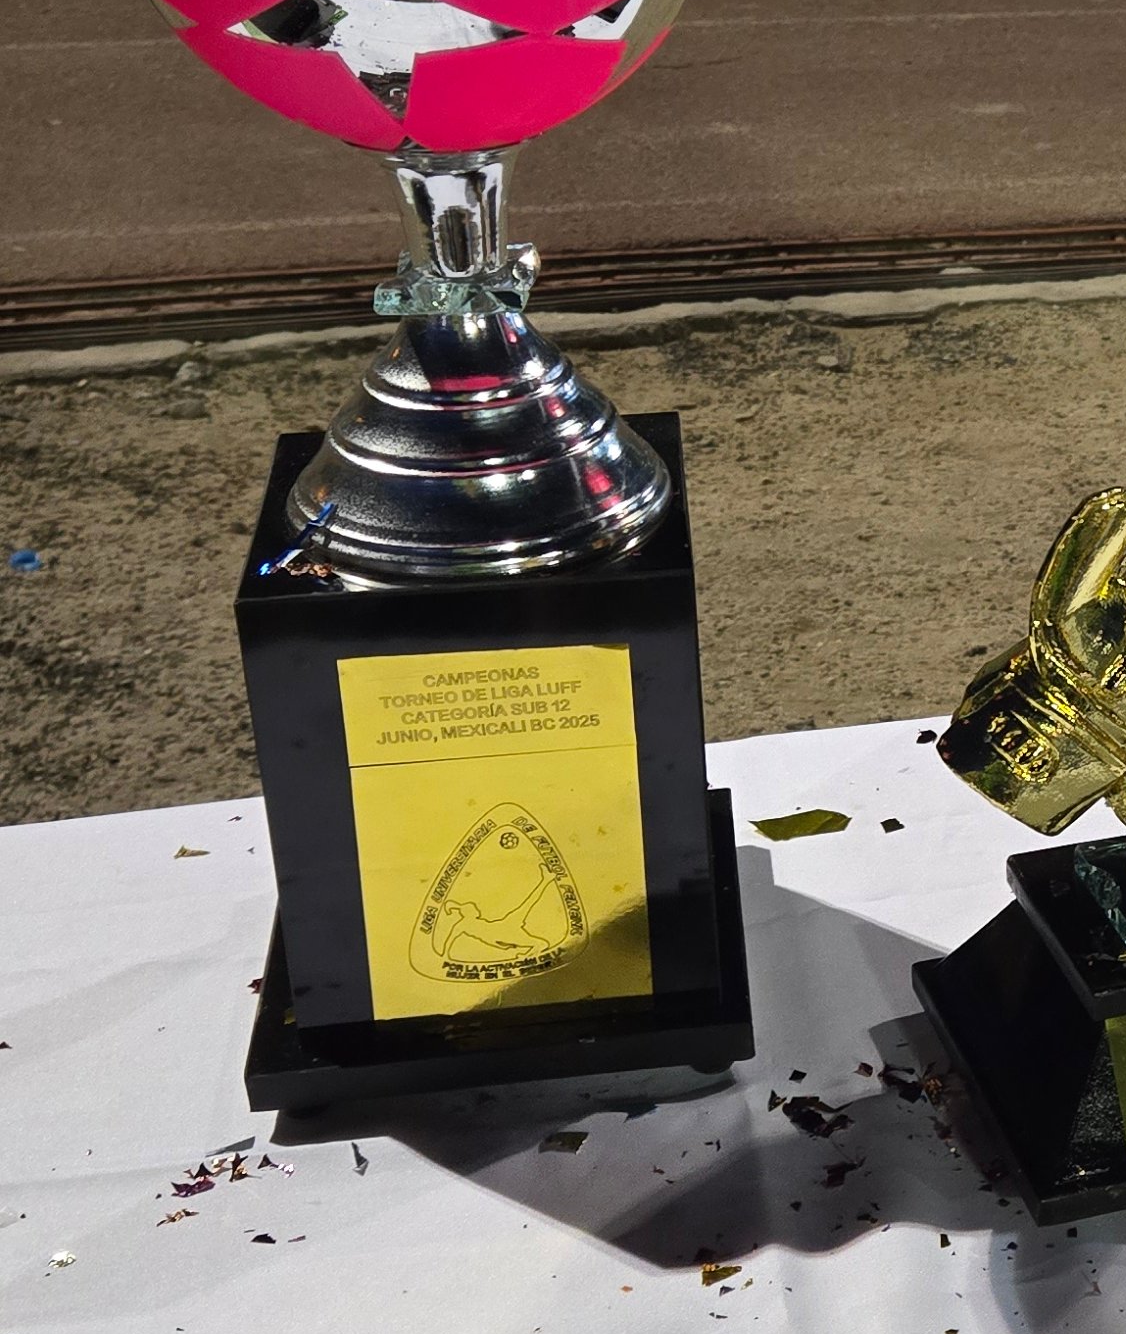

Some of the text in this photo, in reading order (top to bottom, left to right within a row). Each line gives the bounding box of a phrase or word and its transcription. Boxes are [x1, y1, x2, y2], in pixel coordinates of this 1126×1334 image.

[422, 667, 540, 688] CAMPEONAS
[378, 680, 583, 710] TORNEO DE LIGA LUFF
[400, 698, 572, 726] CATEGORÍA SUB 12
[376, 713, 601, 746] JUNIO, MEXICALI BC 2025
